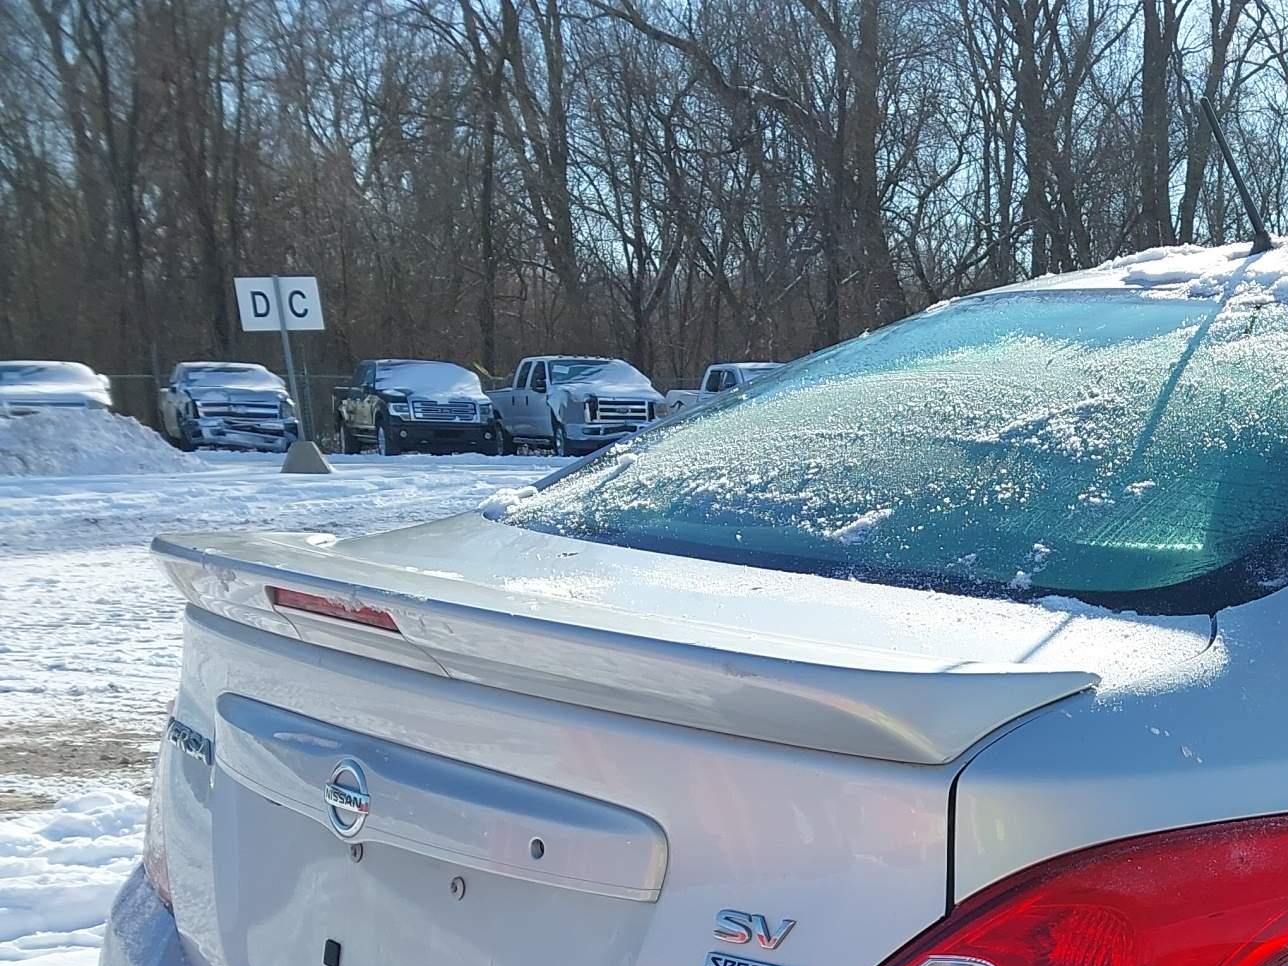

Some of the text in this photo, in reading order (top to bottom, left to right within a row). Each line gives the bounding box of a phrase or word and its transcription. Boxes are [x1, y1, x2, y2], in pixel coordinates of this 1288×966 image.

[250, 289, 309, 319] D C
[325, 786, 364, 809] NISSAN
[713, 908, 798, 950] SV
